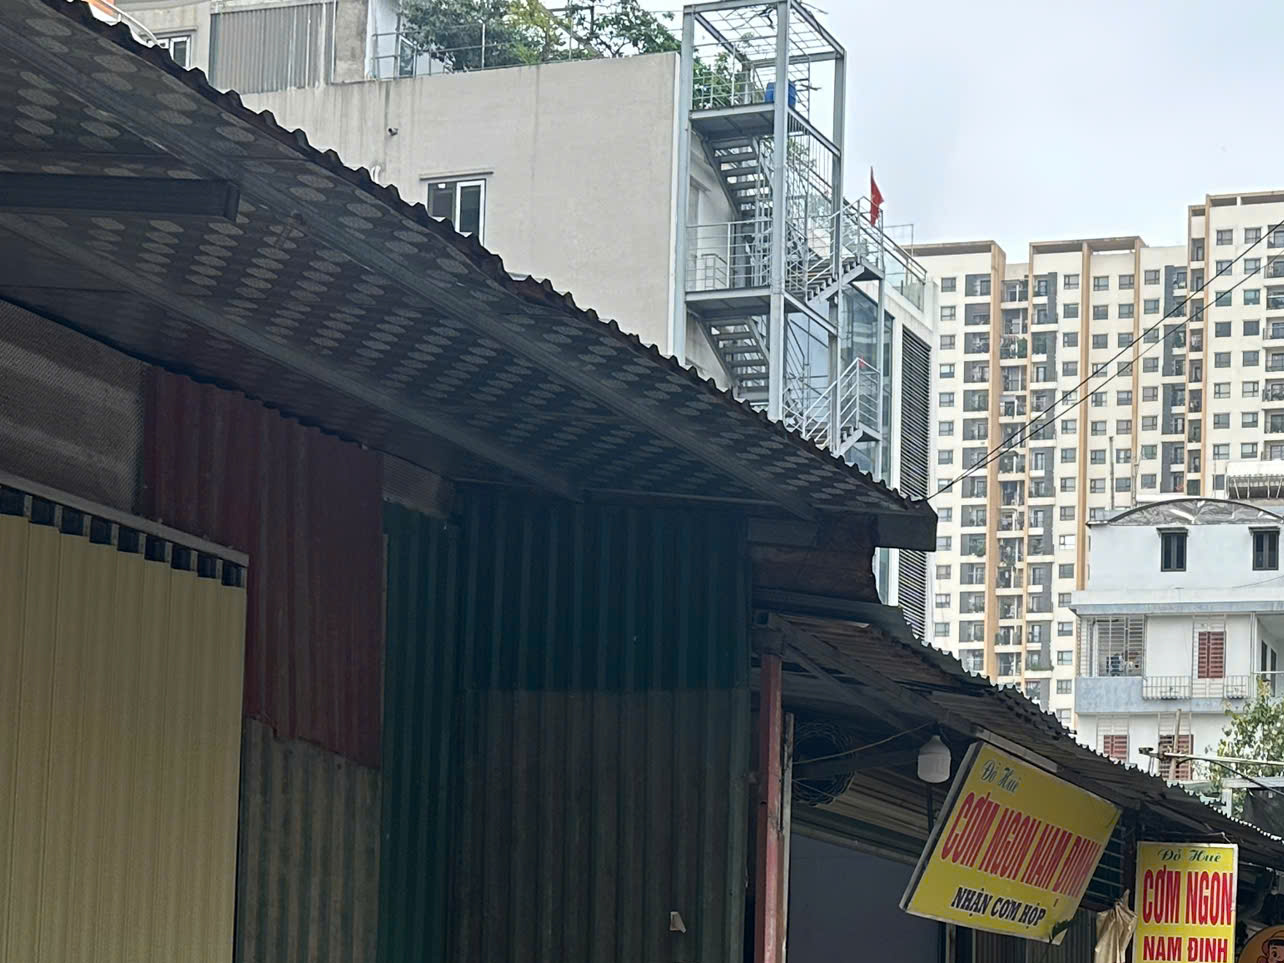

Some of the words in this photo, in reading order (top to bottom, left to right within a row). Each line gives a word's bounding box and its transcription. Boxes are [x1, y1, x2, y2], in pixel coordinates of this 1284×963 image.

[940, 791, 1000, 868] CƠM
[978, 807, 1041, 881] NGON
[1020, 823, 1073, 891] NAM
[951, 887, 993, 917] NHẬN
[990, 896, 1022, 922] CƠM
[1020, 902, 1047, 929] HỘP
[1143, 865, 1181, 925] CƠM
[1185, 871, 1233, 926] NGON
[1143, 936, 1182, 962] NAM
